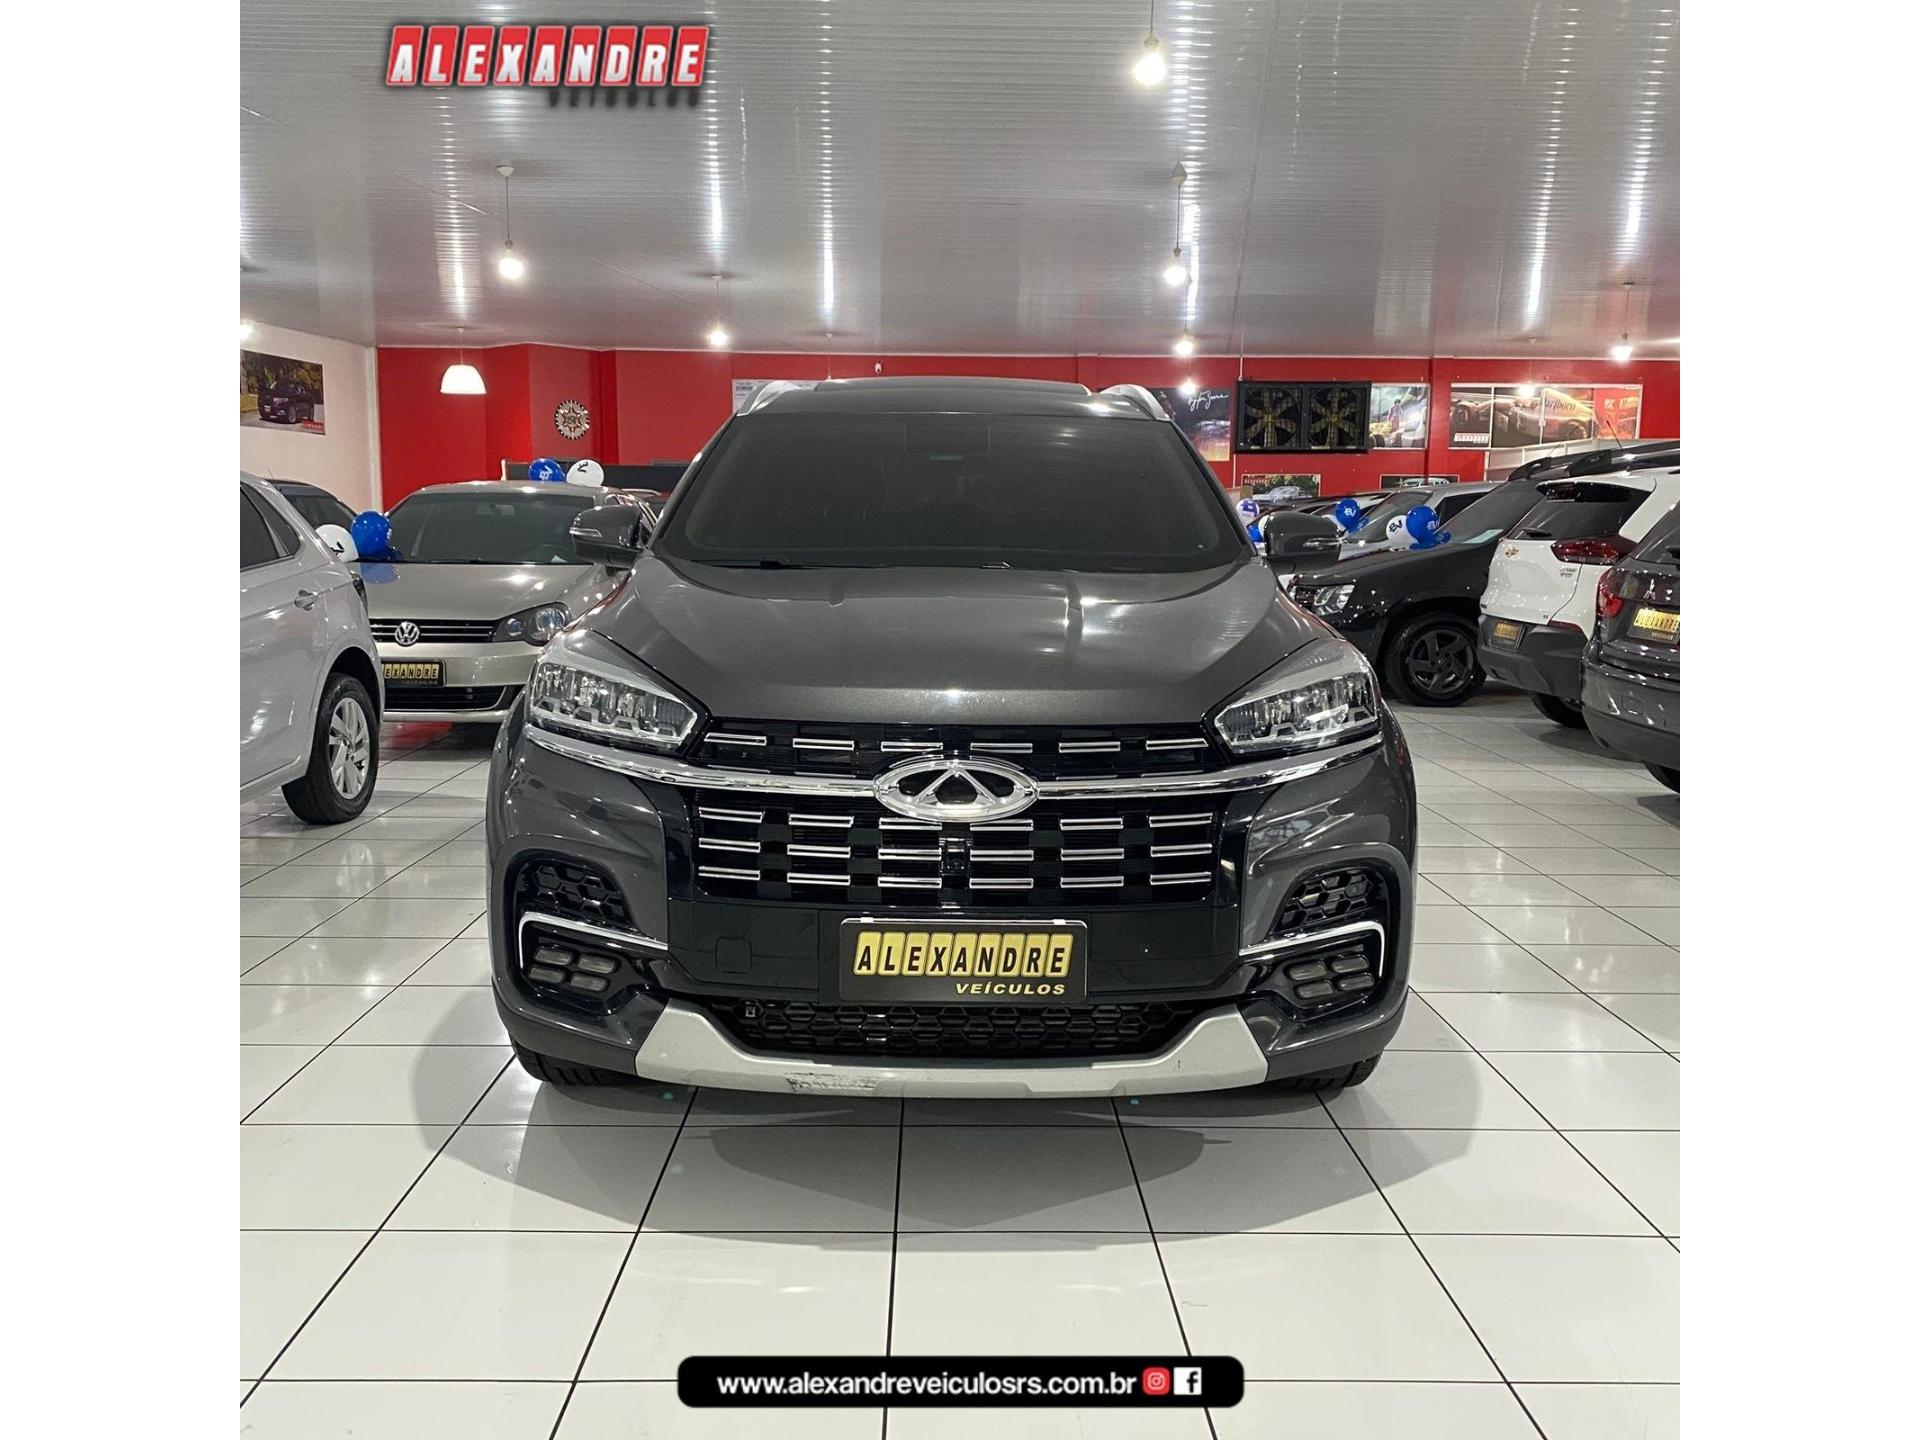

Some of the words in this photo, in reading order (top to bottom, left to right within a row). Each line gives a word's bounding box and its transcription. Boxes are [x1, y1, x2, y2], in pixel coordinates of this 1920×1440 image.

[384, 667, 439, 678] EXANDRE
[857, 945, 1065, 974] ALEXANDRE
[956, 981, 1066, 995] VEÍCULOS
